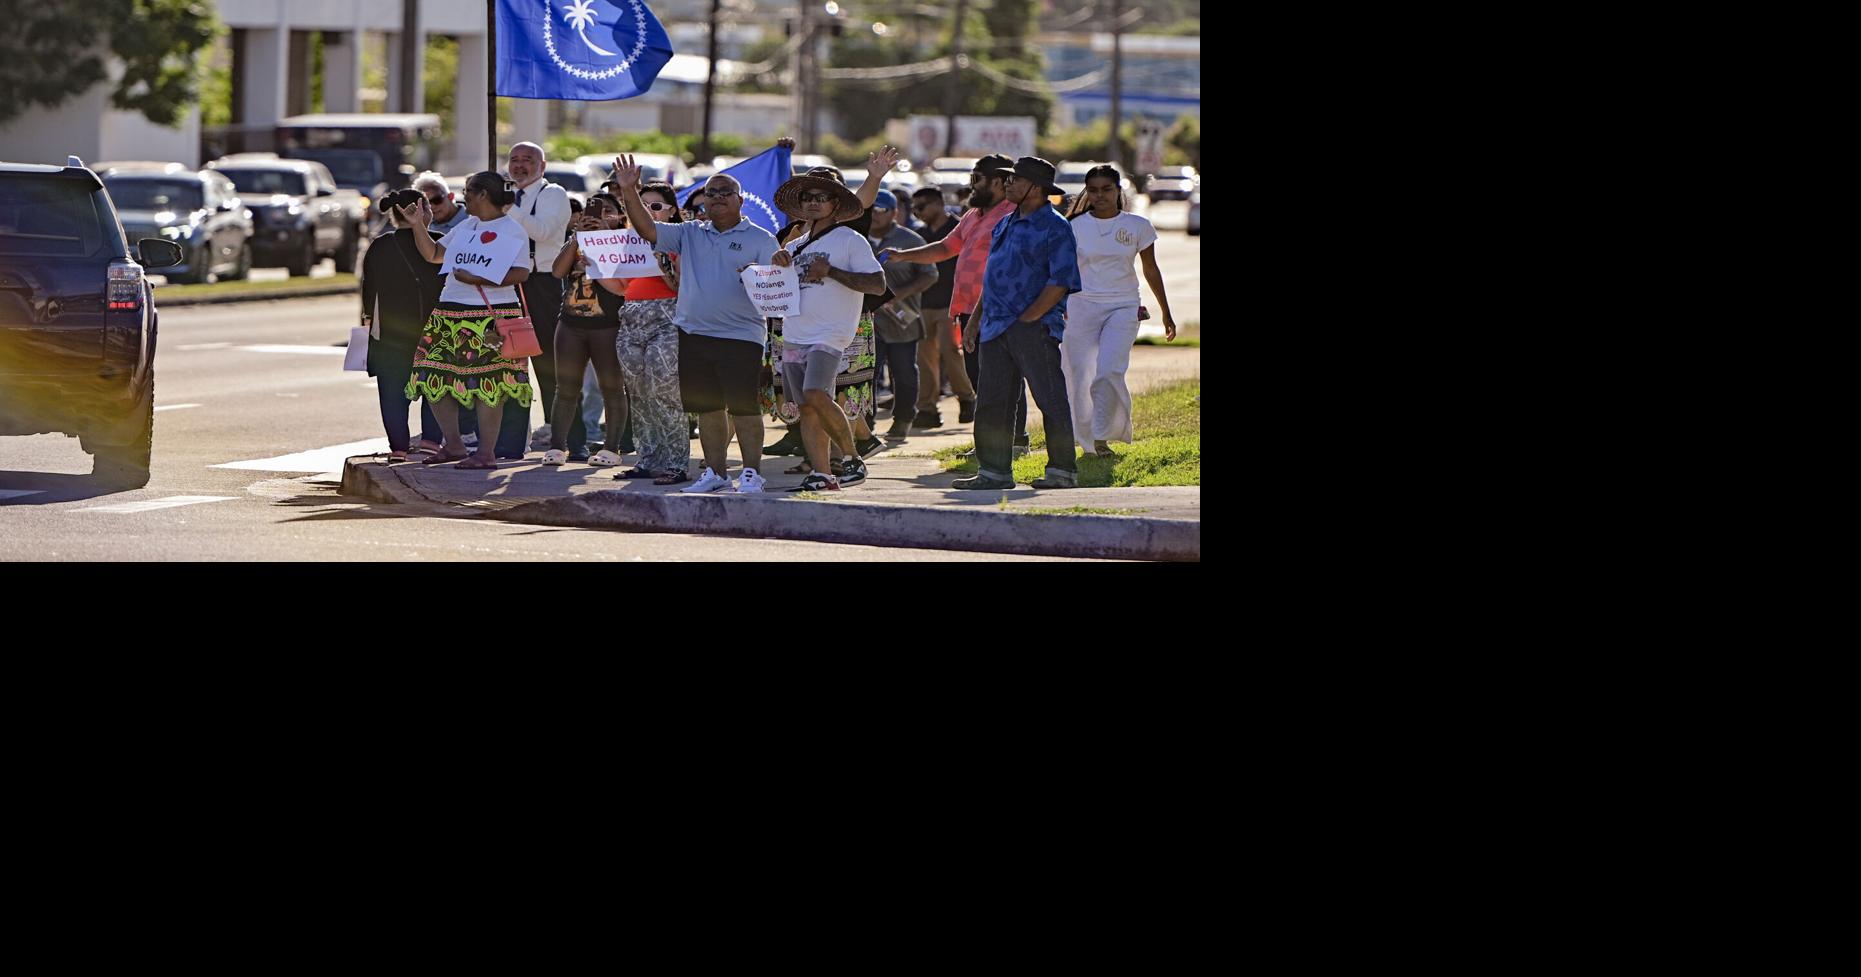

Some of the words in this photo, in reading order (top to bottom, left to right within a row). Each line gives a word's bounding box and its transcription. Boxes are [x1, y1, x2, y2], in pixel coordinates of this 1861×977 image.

[455, 253, 492, 267] GUAM
[598, 254, 607, 264] 4
[609, 253, 646, 264] GUAM
